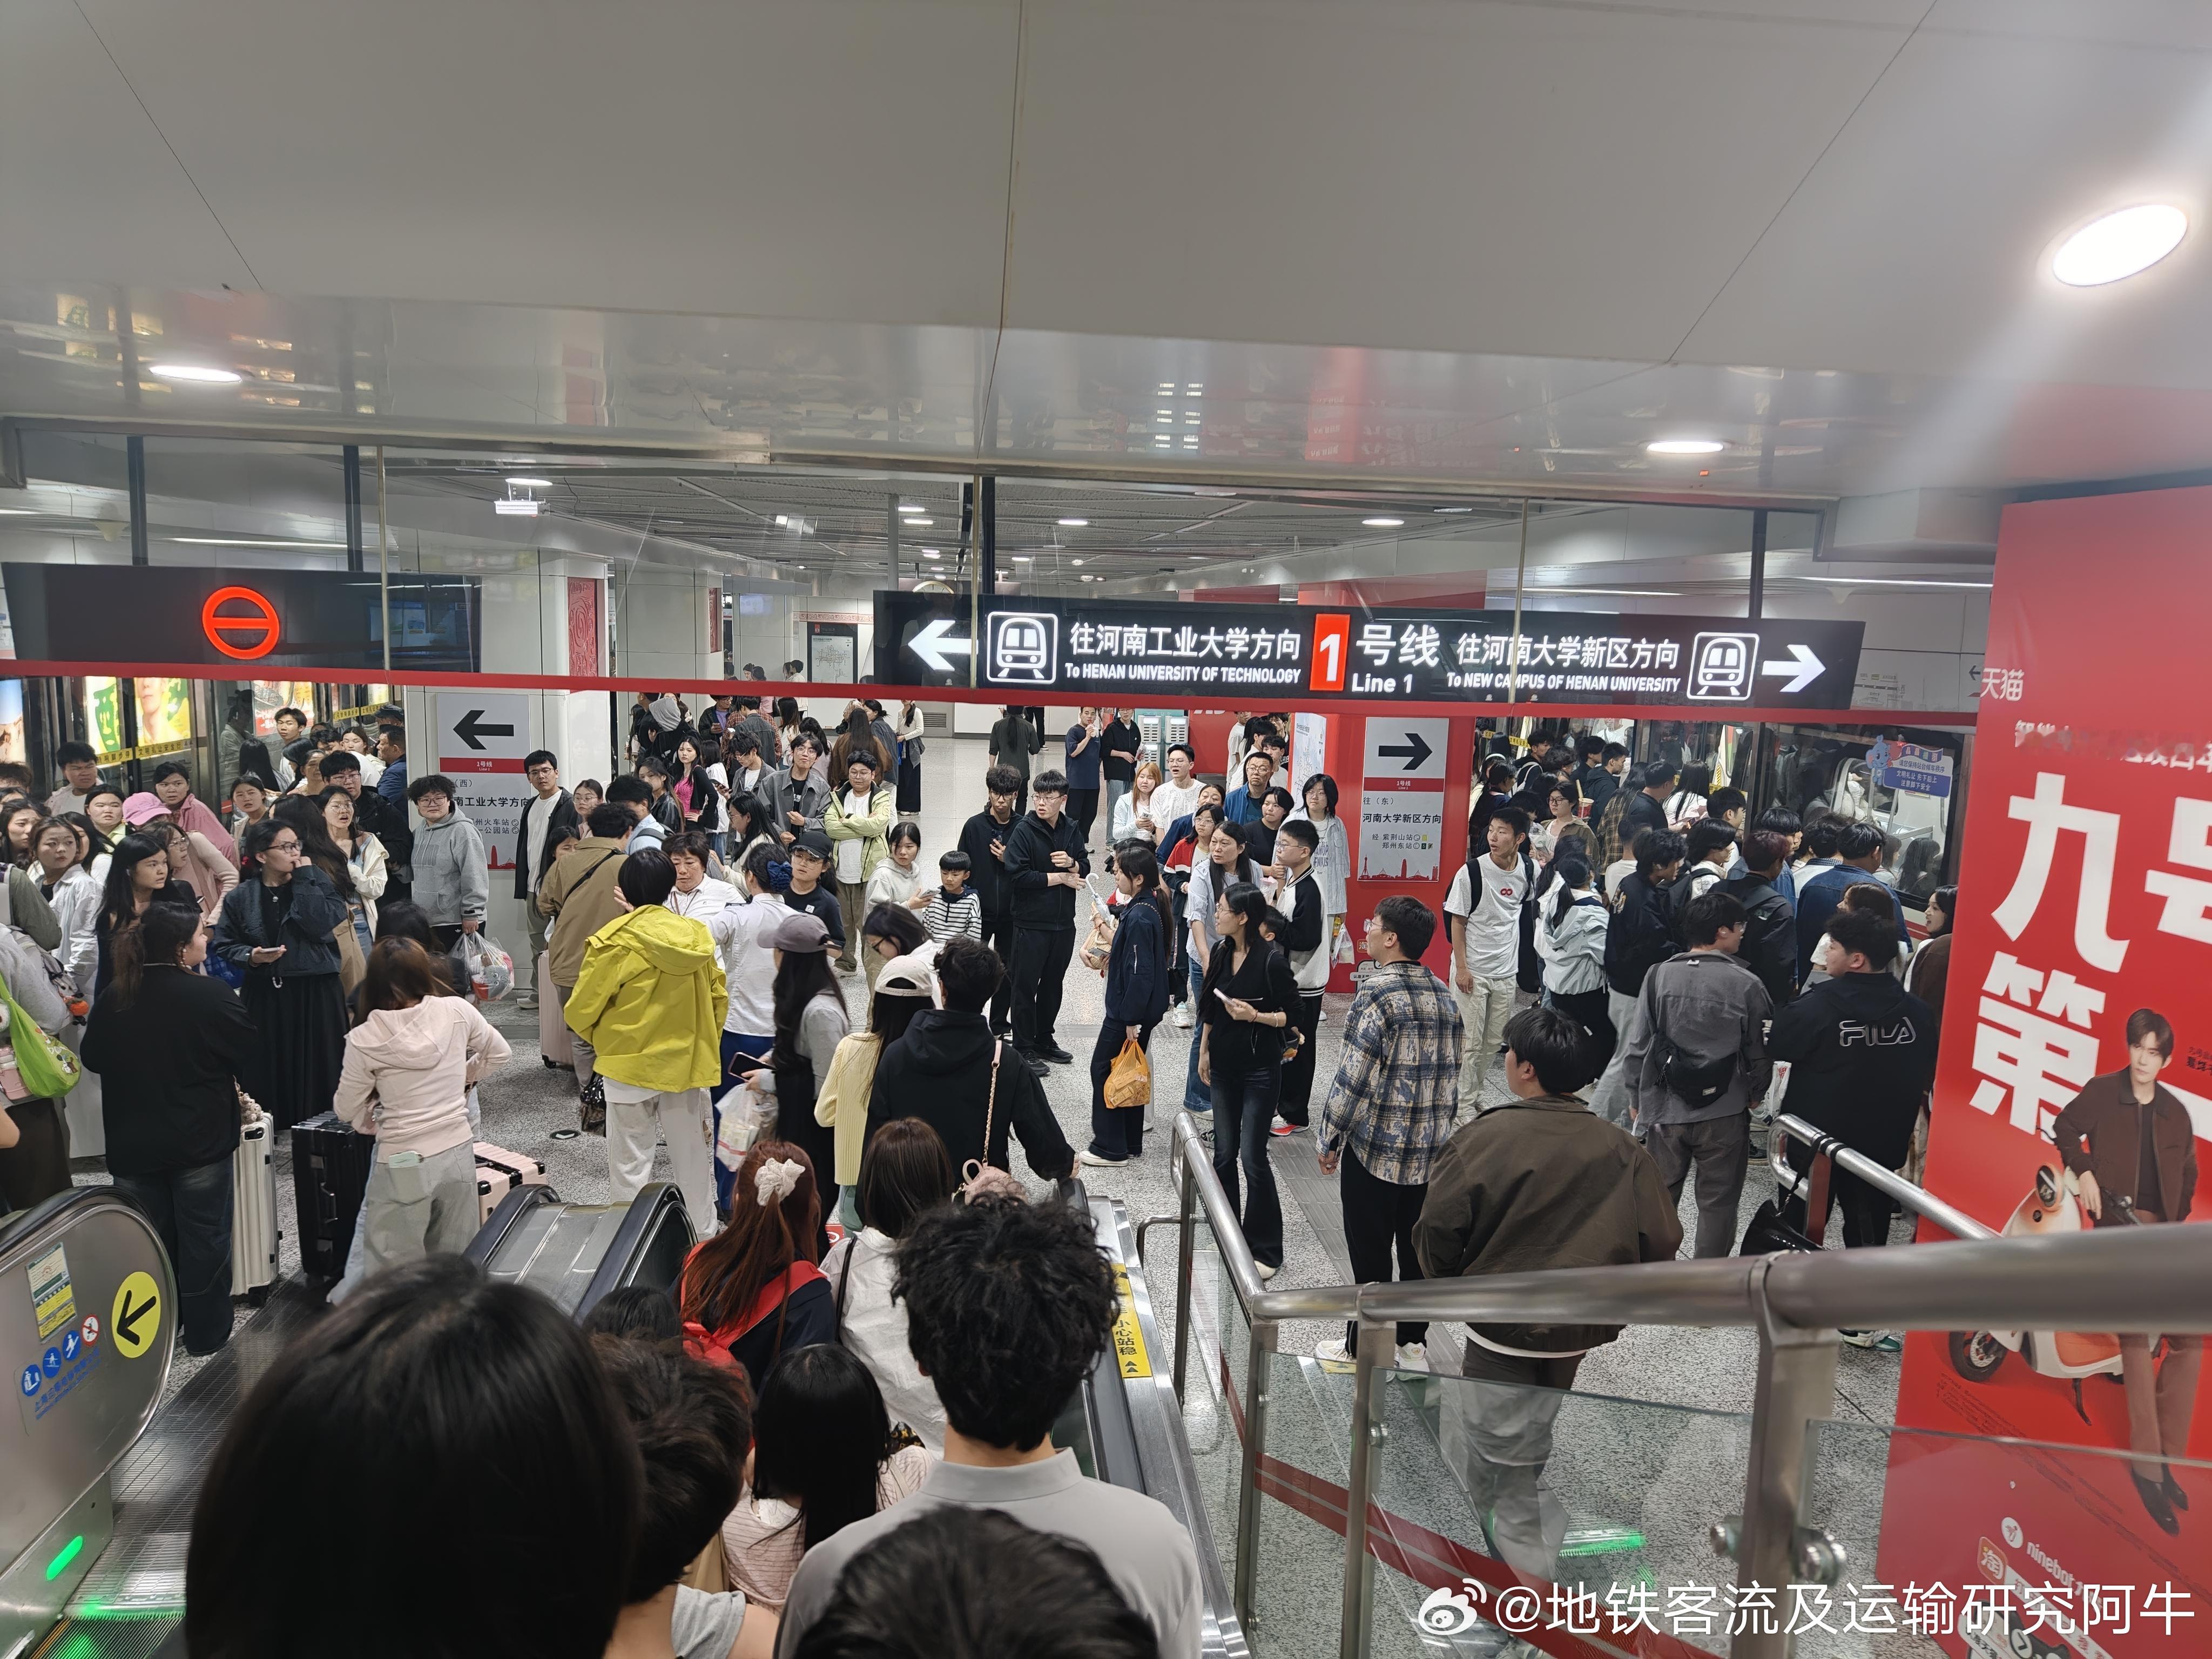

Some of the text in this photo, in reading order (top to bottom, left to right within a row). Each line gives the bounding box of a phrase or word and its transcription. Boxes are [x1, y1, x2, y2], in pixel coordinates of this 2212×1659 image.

[1070, 622, 1301, 660] 往河南工业大学方向
[1320, 624, 1440, 682] 1 号线
[1456, 631, 1679, 670] 往河南大学新区方向
[1065, 663, 1301, 684] To HENAN UNIVERSITY OF TECHNOLOGY
[1352, 673, 1413, 693] Line 1
[1447, 672, 1461, 687] To
[1463, 673, 1494, 687] NEW
[1547, 675, 1564, 689] OF
[1566, 675, 1609, 691] HENAN
[1610, 677, 1681, 692] UNIVERSITY
[1980, 667, 2025, 702] 天猫
[1363, 813, 1441, 824] 河南大学新区方向
[1838, 1016, 1917, 1047] FILA
[1116, 1319, 1137, 1356] 小心站稳
[2026, 1541, 2075, 1590] ninebot
